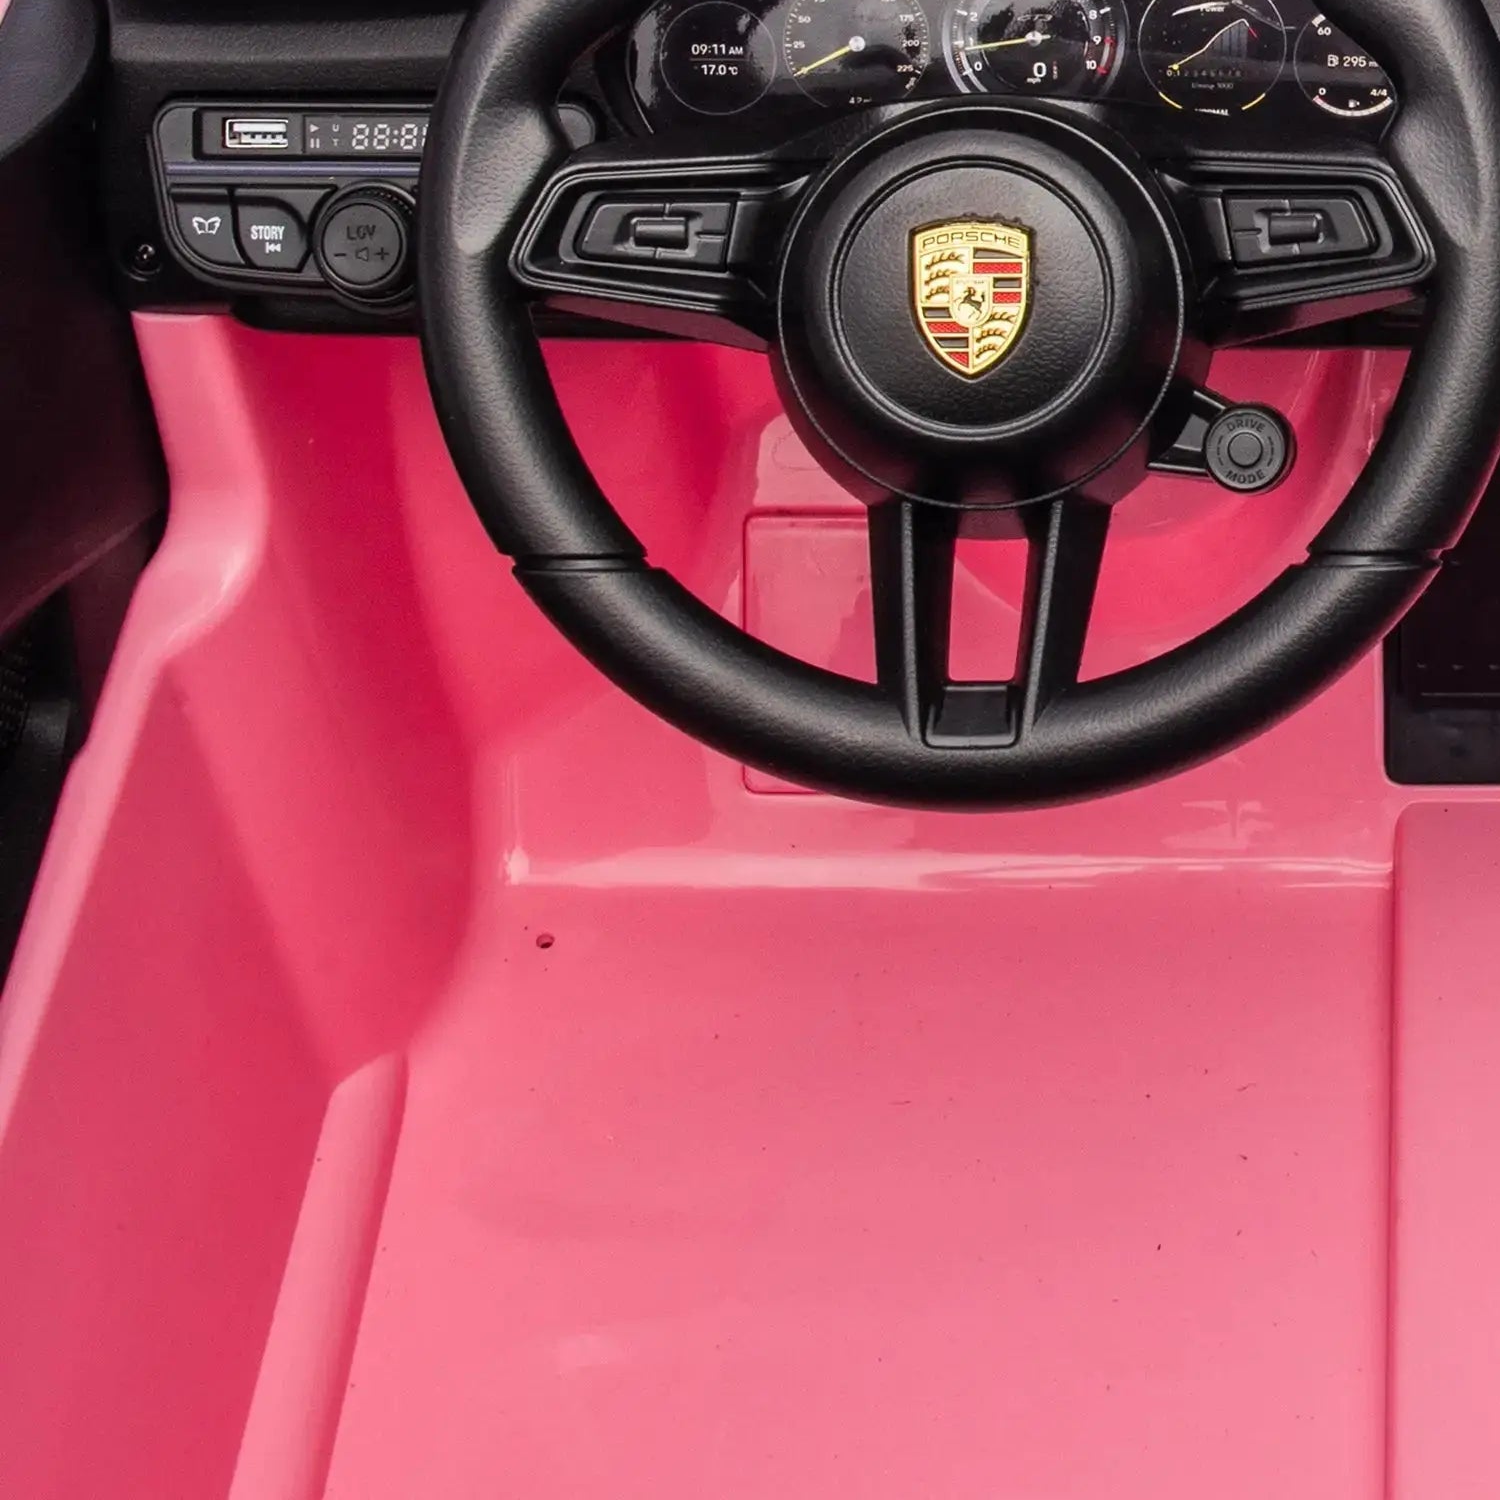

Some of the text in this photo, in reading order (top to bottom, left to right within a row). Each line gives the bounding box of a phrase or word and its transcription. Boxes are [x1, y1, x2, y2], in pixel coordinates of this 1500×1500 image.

[970, 12, 978, 22] 2
[1088, 9, 1097, 20] 8
[1317, 27, 1332, 36] 60
[1093, 35, 1102, 45] 9
[691, 44, 743, 55] 09:11 AM
[974, 62, 982, 71] 0
[1085, 60, 1097, 70] 10
[1343, 56, 1367, 68] 295
[701, 64, 727, 75] 17.0
[1033, 62, 1047, 78] 0
[1318, 88, 1326, 96] 0
[1370, 88, 1388, 97] 4/4
[250, 224, 285, 241] STORY
[922, 231, 1021, 250] PORSCHE
[1226, 418, 1266, 433] DRIVE
[1225, 469, 1266, 485] MODE
